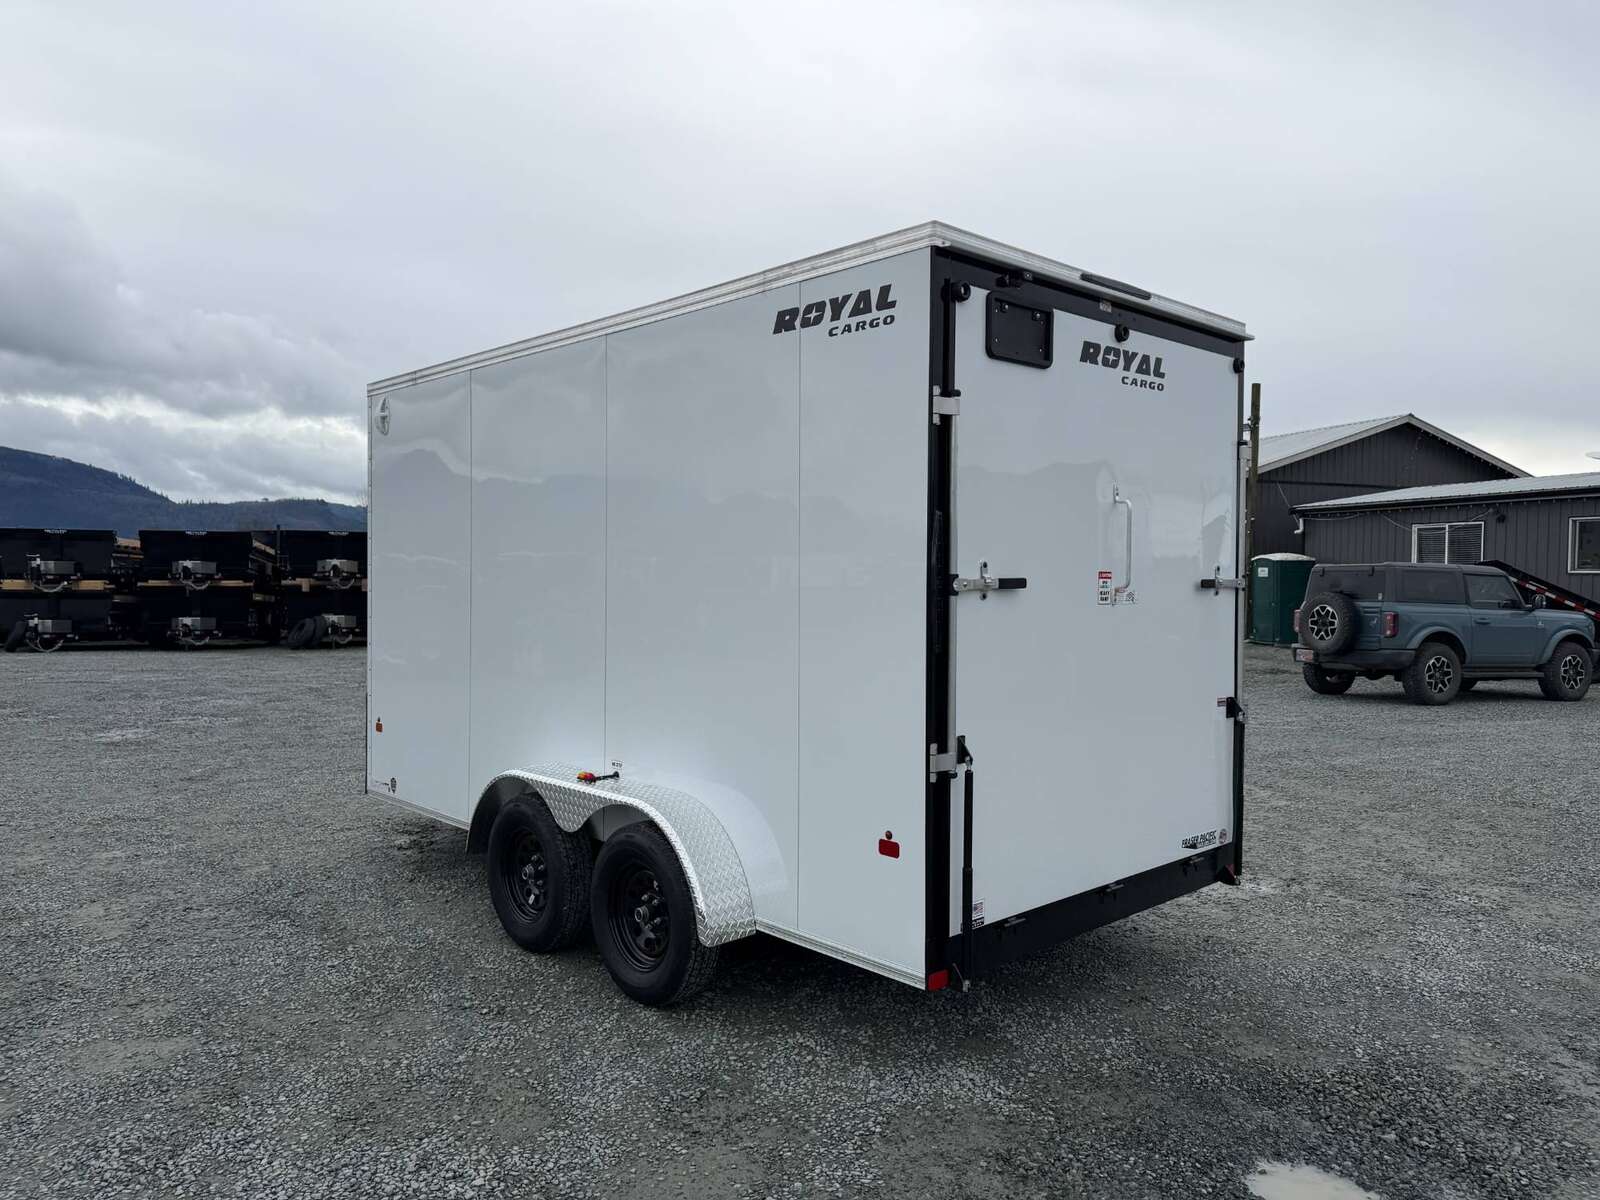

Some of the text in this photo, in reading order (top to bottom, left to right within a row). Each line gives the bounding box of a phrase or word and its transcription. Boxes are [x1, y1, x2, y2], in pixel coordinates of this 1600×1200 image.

[773, 284, 897, 334] ROYAL
[828, 315, 895, 337] CARGO
[1080, 340, 1165, 379] ROYAL
[1121, 376, 1164, 392] CARGO
